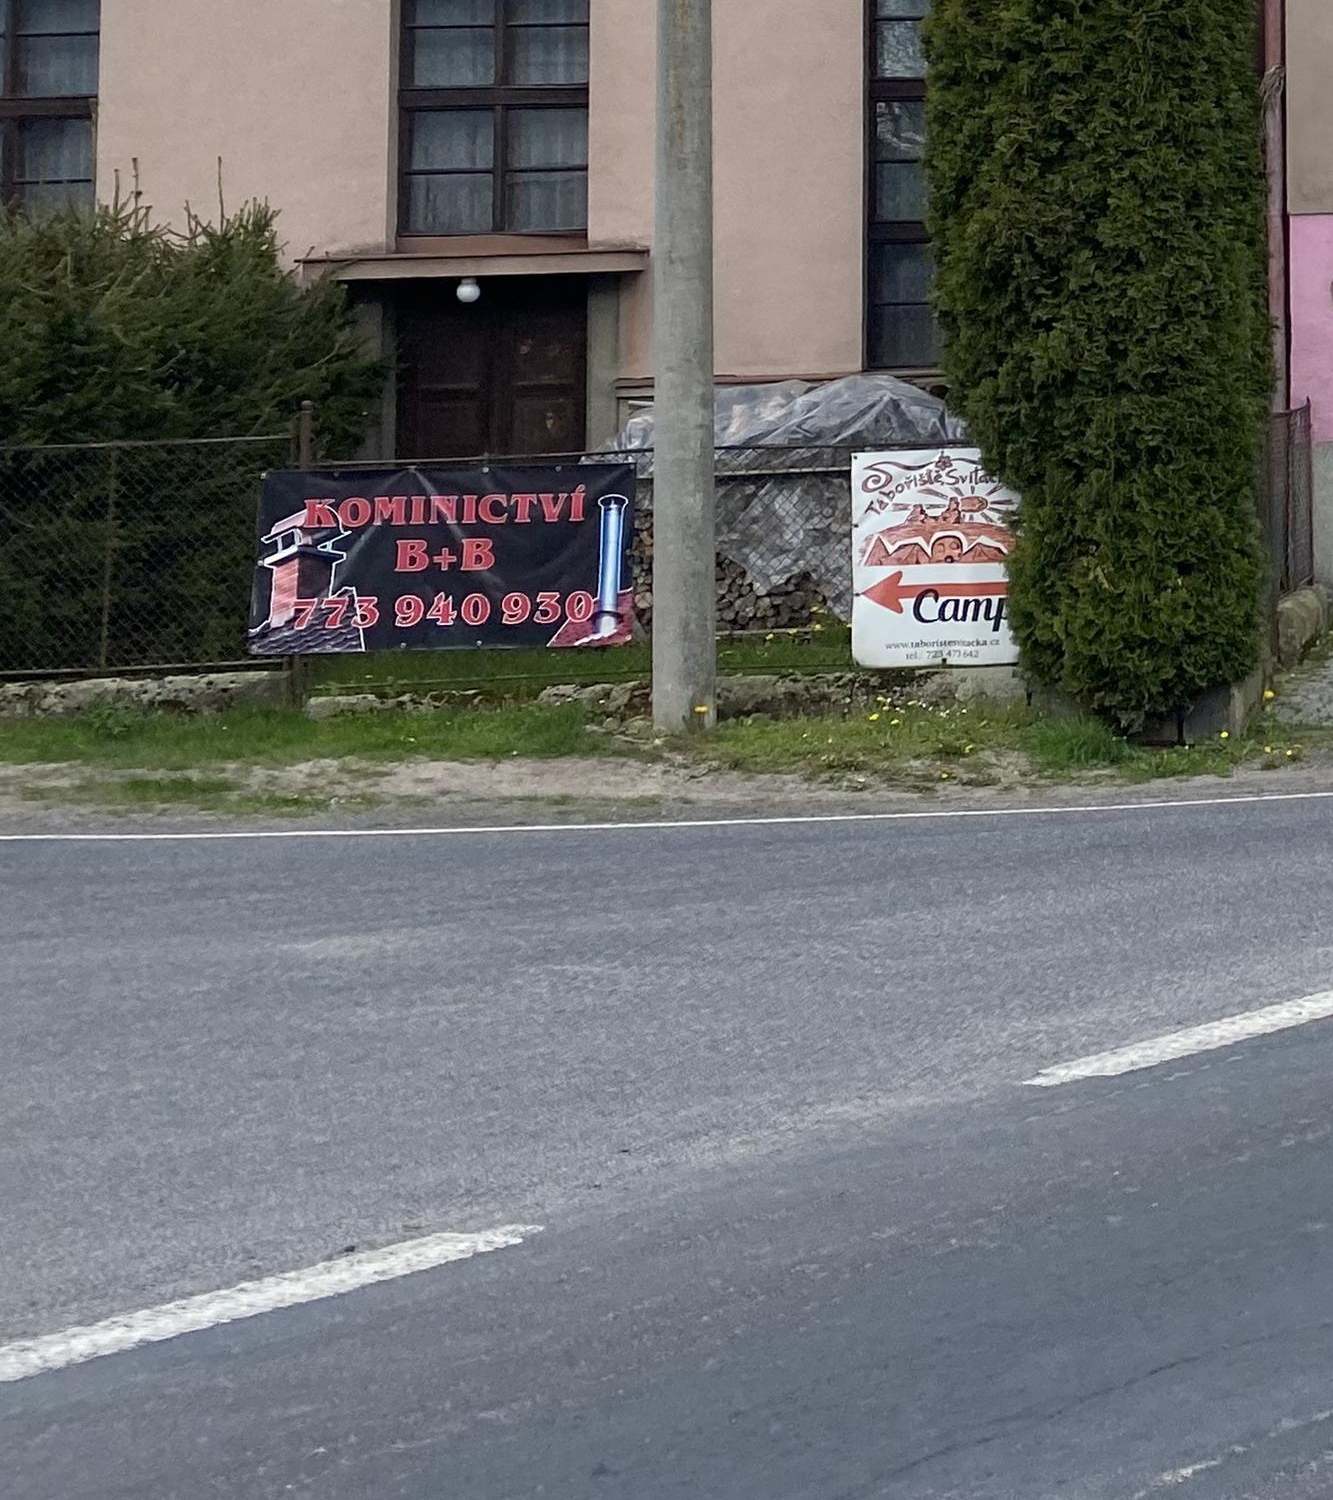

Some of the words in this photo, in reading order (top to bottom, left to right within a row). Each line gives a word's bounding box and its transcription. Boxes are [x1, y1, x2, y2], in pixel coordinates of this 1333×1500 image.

[303, 484, 587, 528] KOMINICTVÍ
[394, 538, 496, 573] B+B
[291, 596, 380, 630] 773
[395, 592, 491, 627] 940
[501, 590, 595, 625] 930
